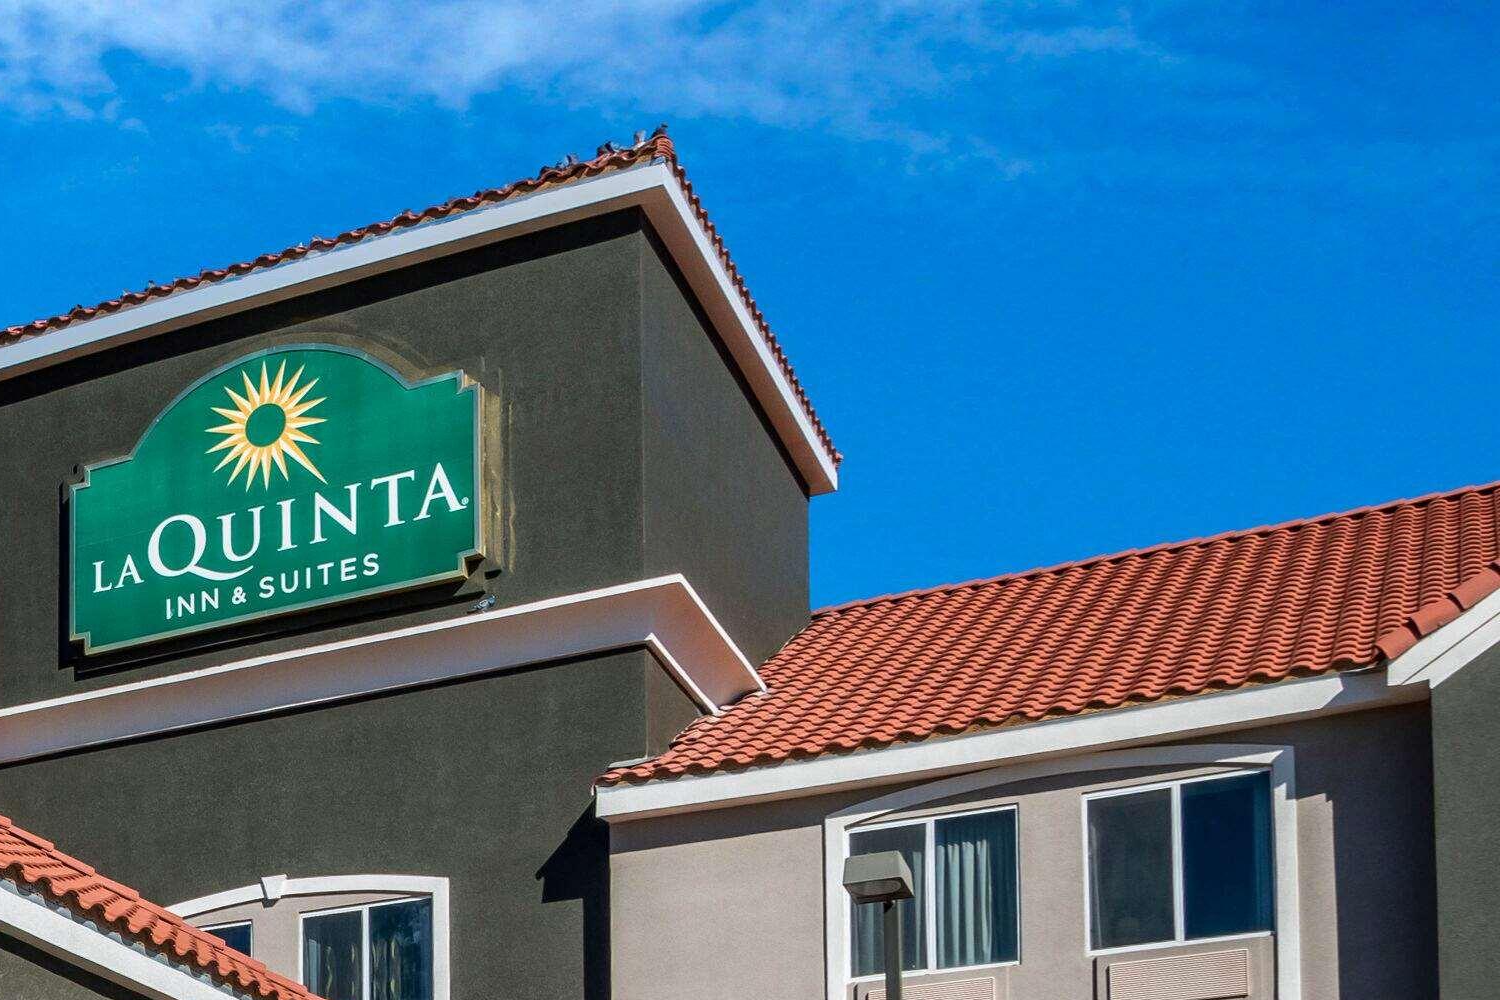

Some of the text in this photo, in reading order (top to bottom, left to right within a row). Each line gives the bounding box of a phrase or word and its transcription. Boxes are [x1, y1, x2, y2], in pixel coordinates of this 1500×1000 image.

[92, 462, 468, 593] LA QUINTA
[165, 552, 381, 620] INN & SUITES
